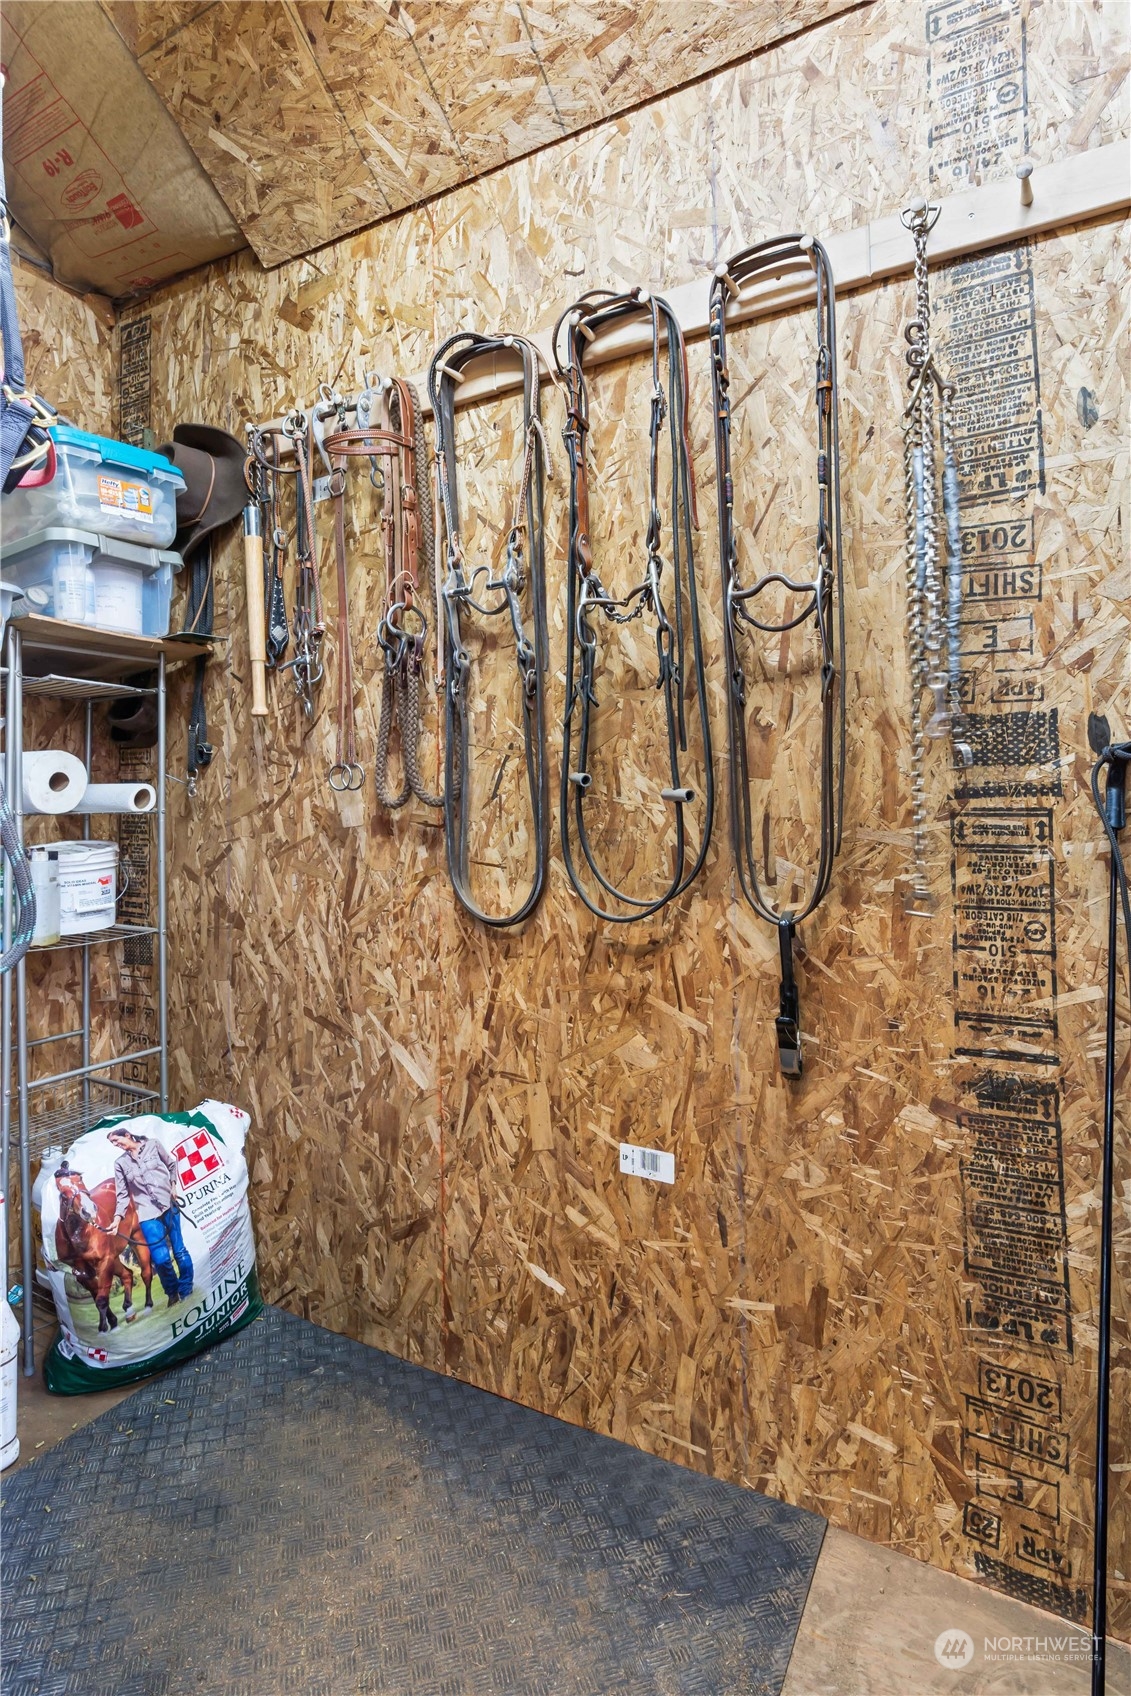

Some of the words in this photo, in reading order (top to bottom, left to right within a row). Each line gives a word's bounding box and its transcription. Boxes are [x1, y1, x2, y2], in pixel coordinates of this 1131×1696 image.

[43, 148, 75, 178] R-19
[101, 479, 119, 488] Hefty
[977, 471, 1008, 491] LP
[959, 524, 1027, 555] 2013
[964, 570, 1035, 597] SHIFT
[982, 625, 998, 649] E
[185, 1172, 232, 1206] PURINA
[171, 1258, 247, 1340] EQUINE
[195, 1281, 249, 1340] JUNIOR
[1002, 1319, 1035, 1341] LP
[985, 1368, 1054, 1409] 2013
[989, 1415, 1061, 1461] SHIFT
[1007, 1474, 1025, 1502] E
[969, 1511, 995, 1539] 25
[1022, 1536, 1063, 1566] APR
